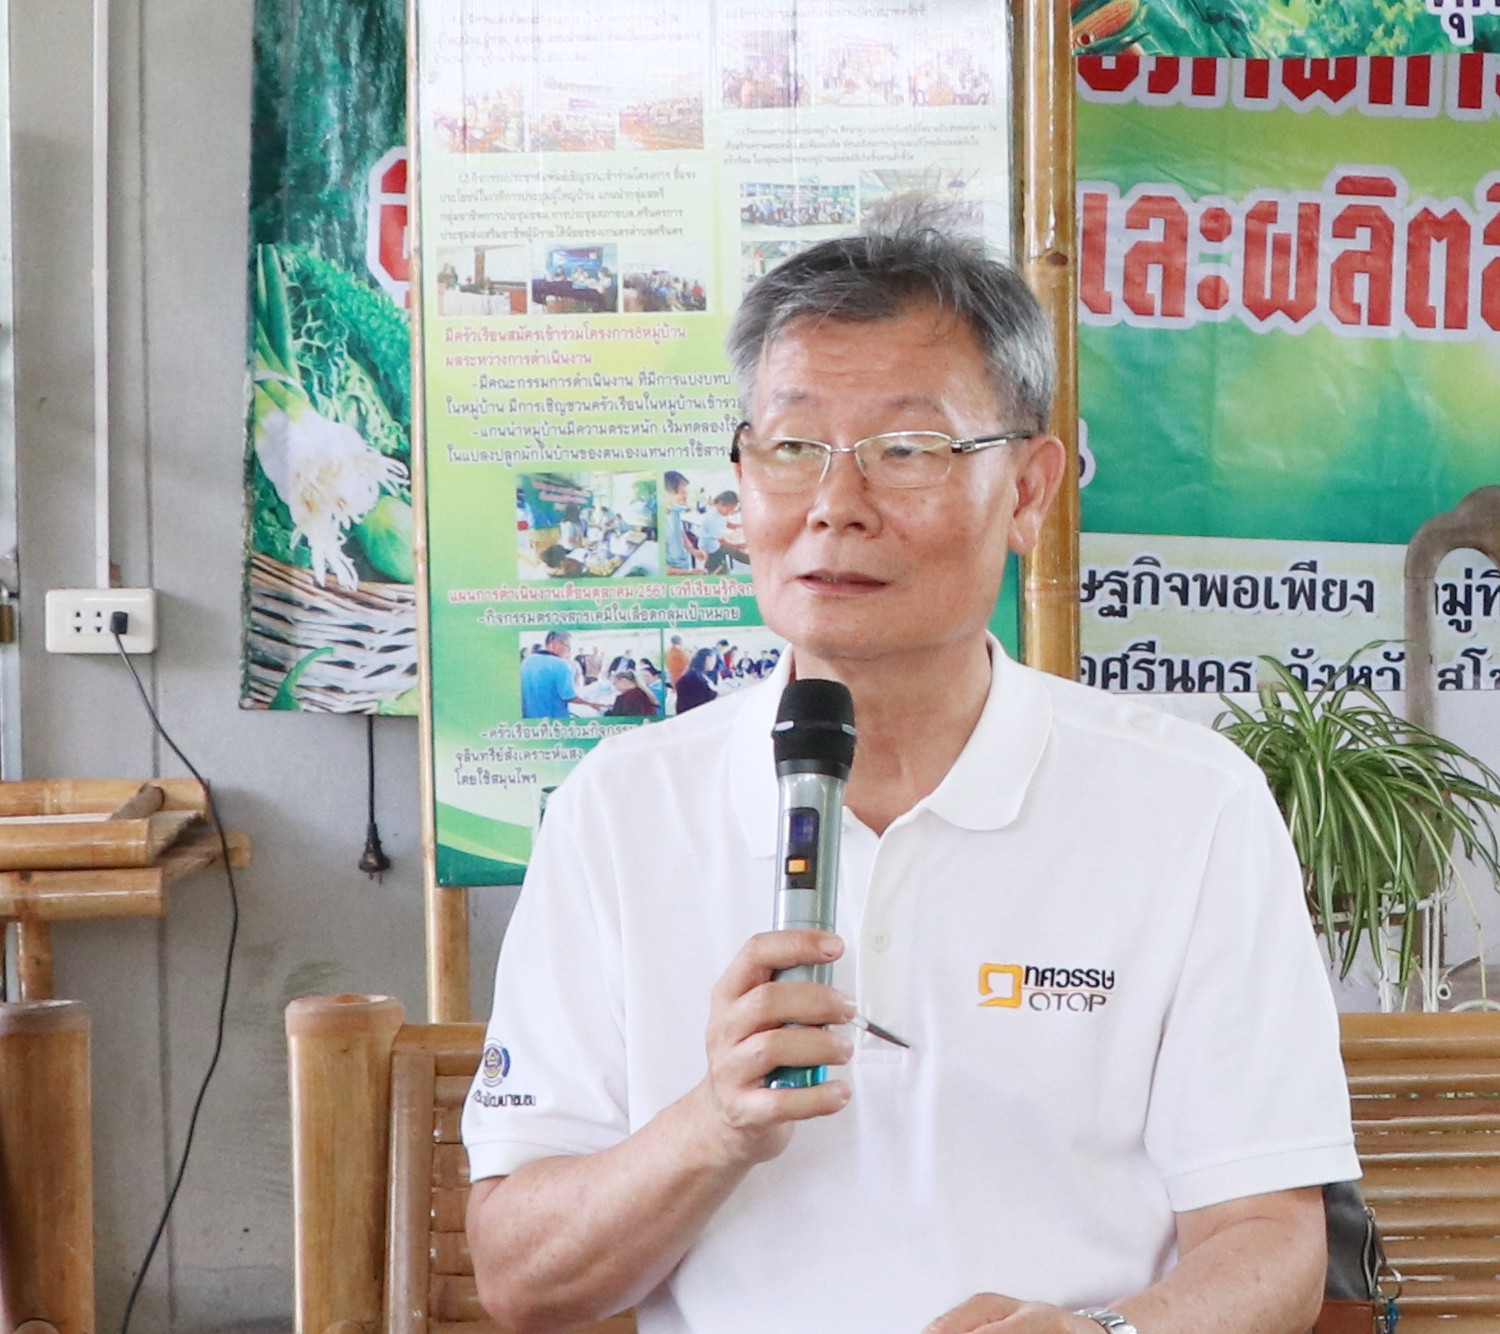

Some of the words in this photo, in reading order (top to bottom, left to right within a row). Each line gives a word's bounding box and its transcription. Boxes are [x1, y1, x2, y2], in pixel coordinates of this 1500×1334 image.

[1023, 965, 1116, 990] ทศวรรษ
[1028, 991, 1108, 1013] OTOP
